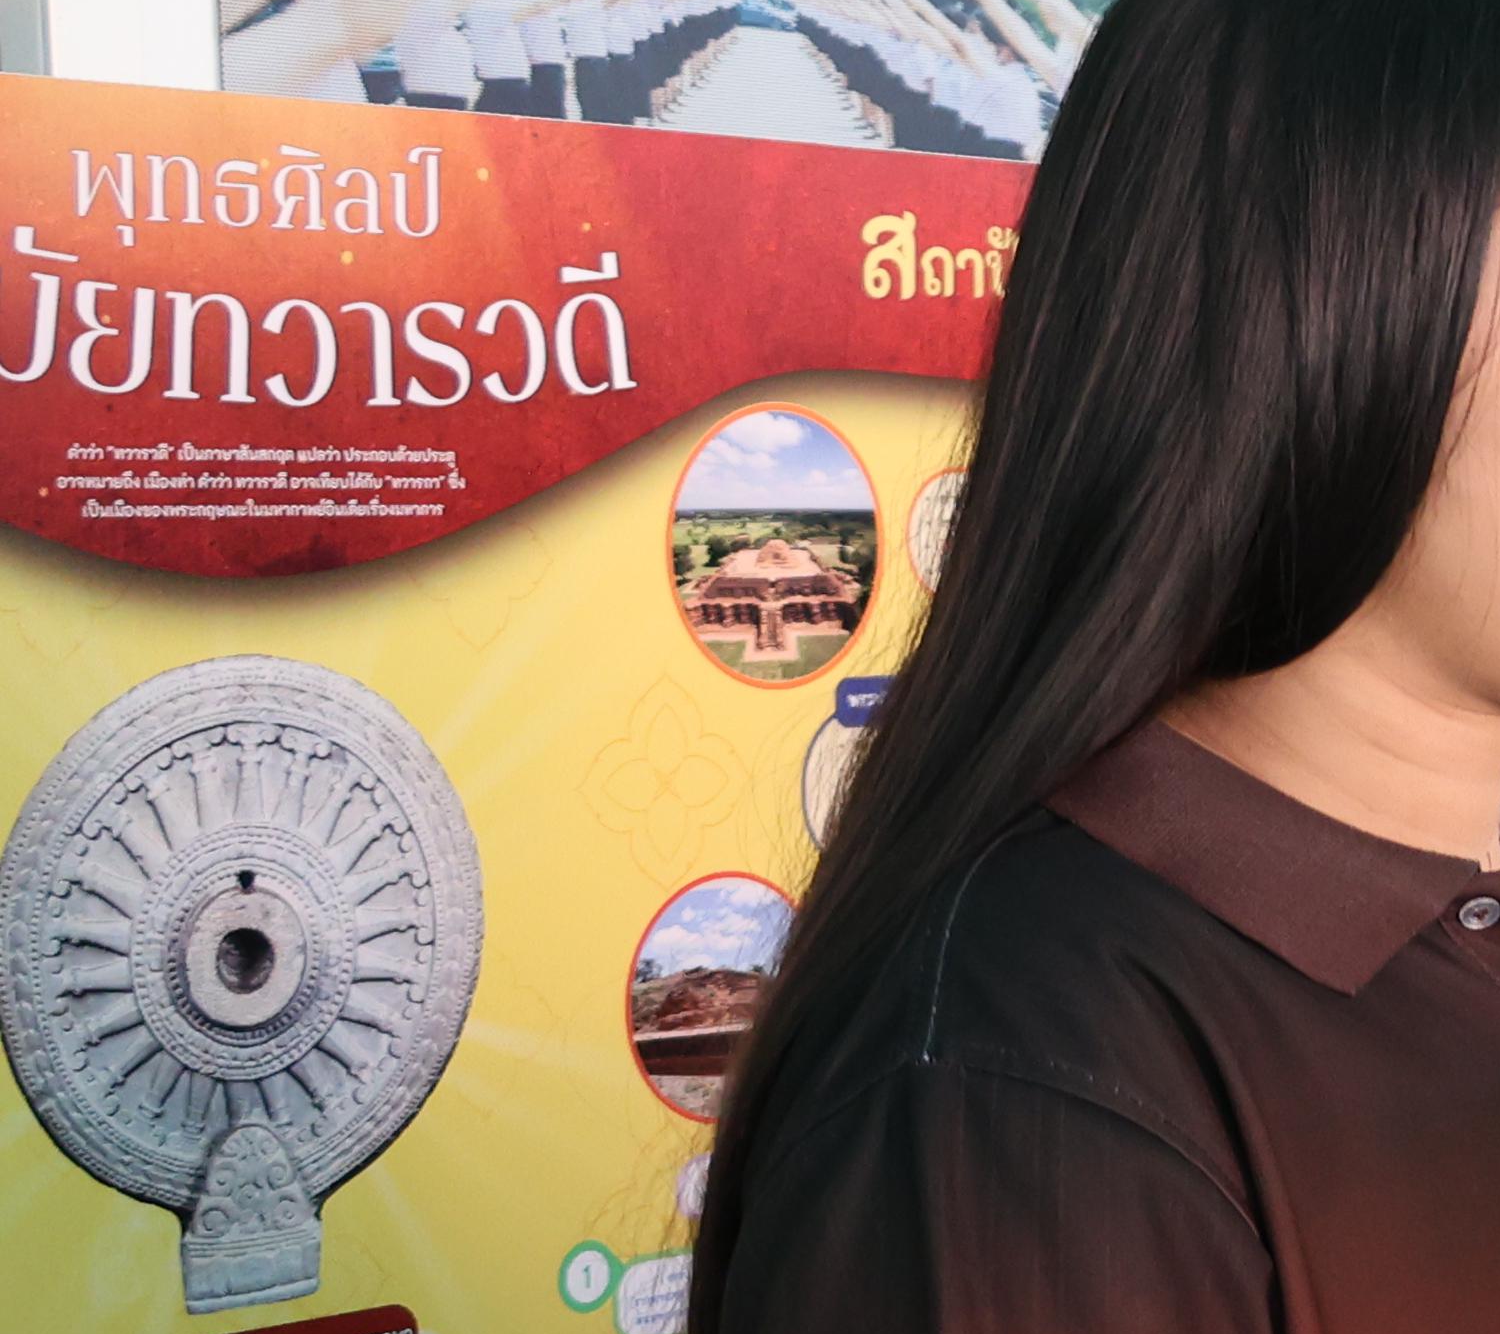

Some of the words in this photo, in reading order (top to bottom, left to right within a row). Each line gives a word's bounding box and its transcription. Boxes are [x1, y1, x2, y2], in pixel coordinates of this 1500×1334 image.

[72, 144, 443, 246] พุทธศิลป์
[582, 1264, 593, 1289] 1
